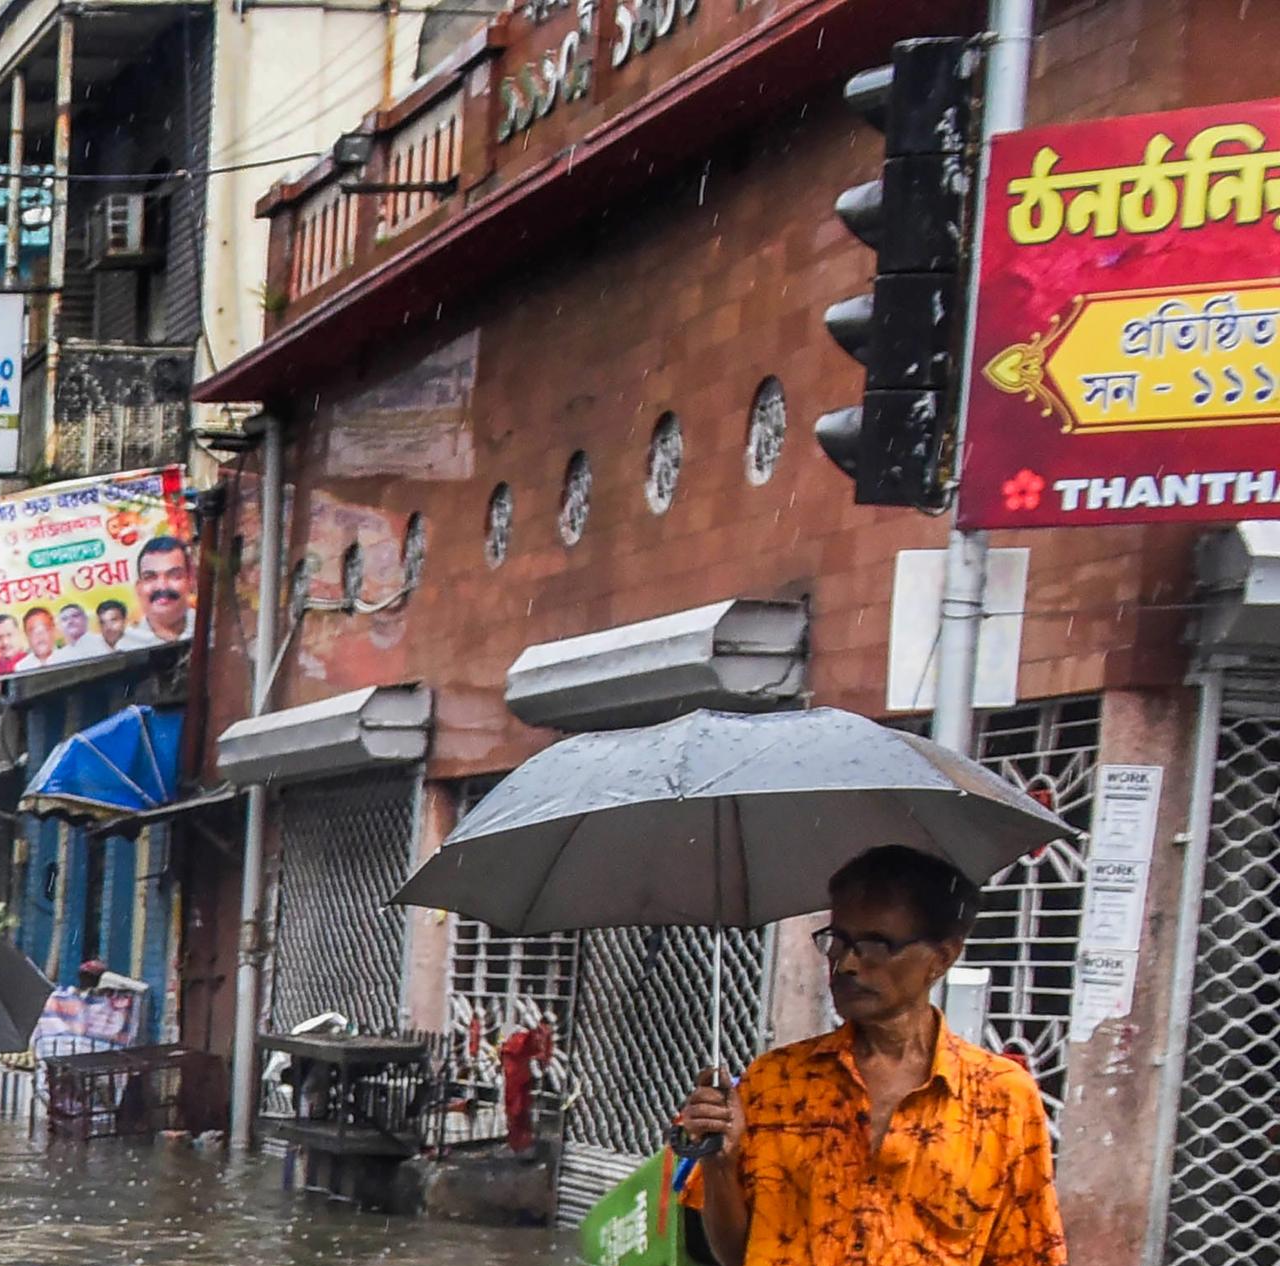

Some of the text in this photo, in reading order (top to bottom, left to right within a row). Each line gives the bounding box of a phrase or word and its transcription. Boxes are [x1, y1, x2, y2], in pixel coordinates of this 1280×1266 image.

[1008, 122, 1280, 246] ঠনঠনি
[1081, 372, 1140, 411] সন
[72, 558, 130, 591] ওঝা
